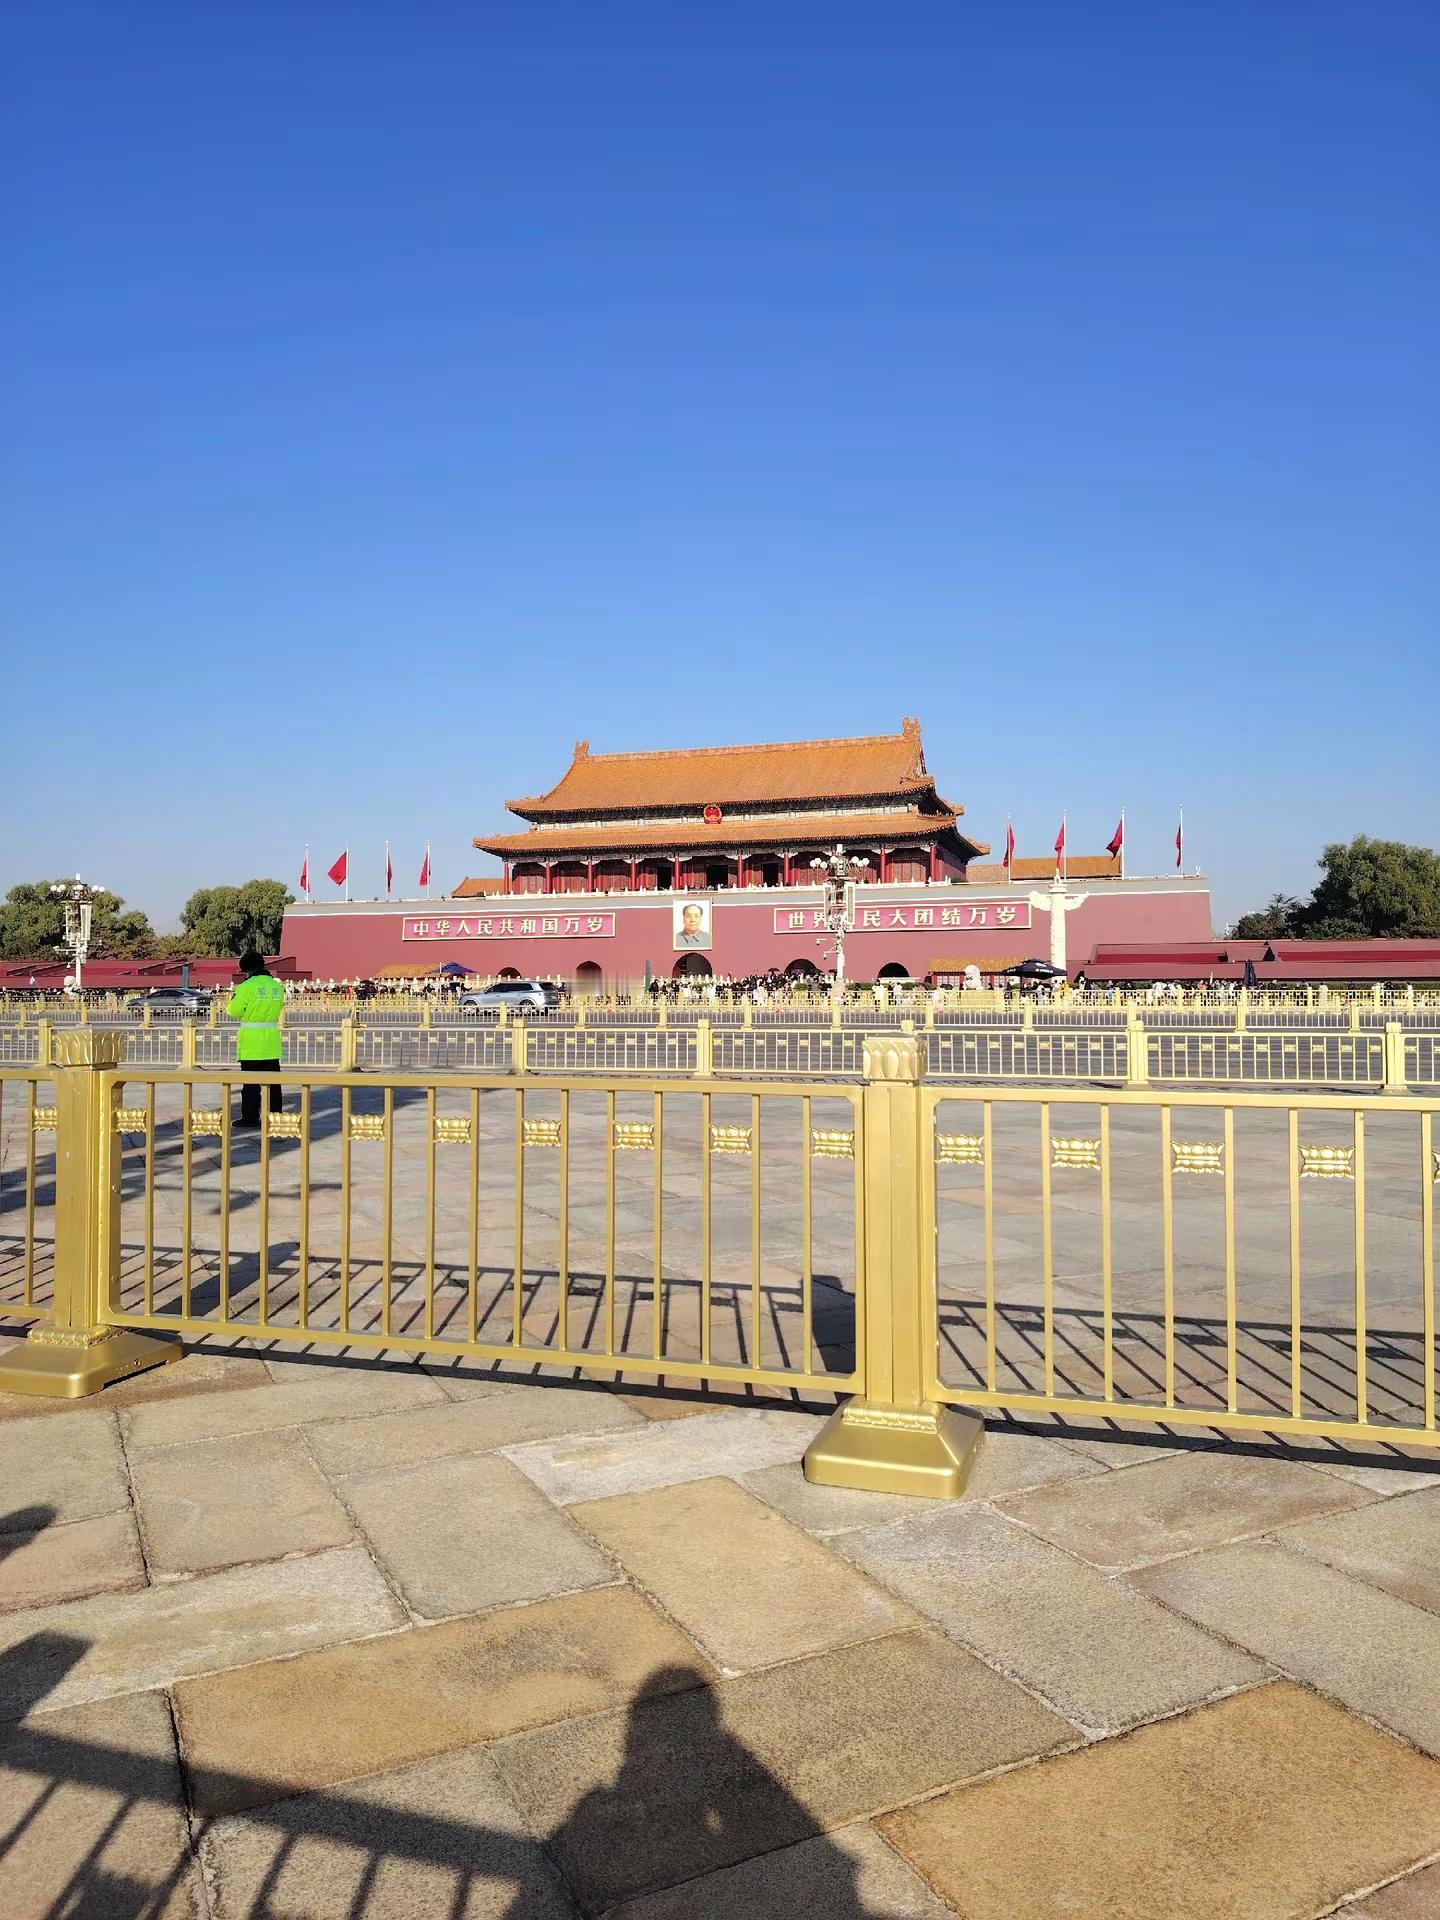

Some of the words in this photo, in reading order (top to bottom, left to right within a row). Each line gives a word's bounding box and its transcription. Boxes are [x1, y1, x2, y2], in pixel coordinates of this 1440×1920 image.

[413, 917, 603, 936] 中华人民共和国万岁
[788, 906, 1016, 928] 世界民大团结万岁
